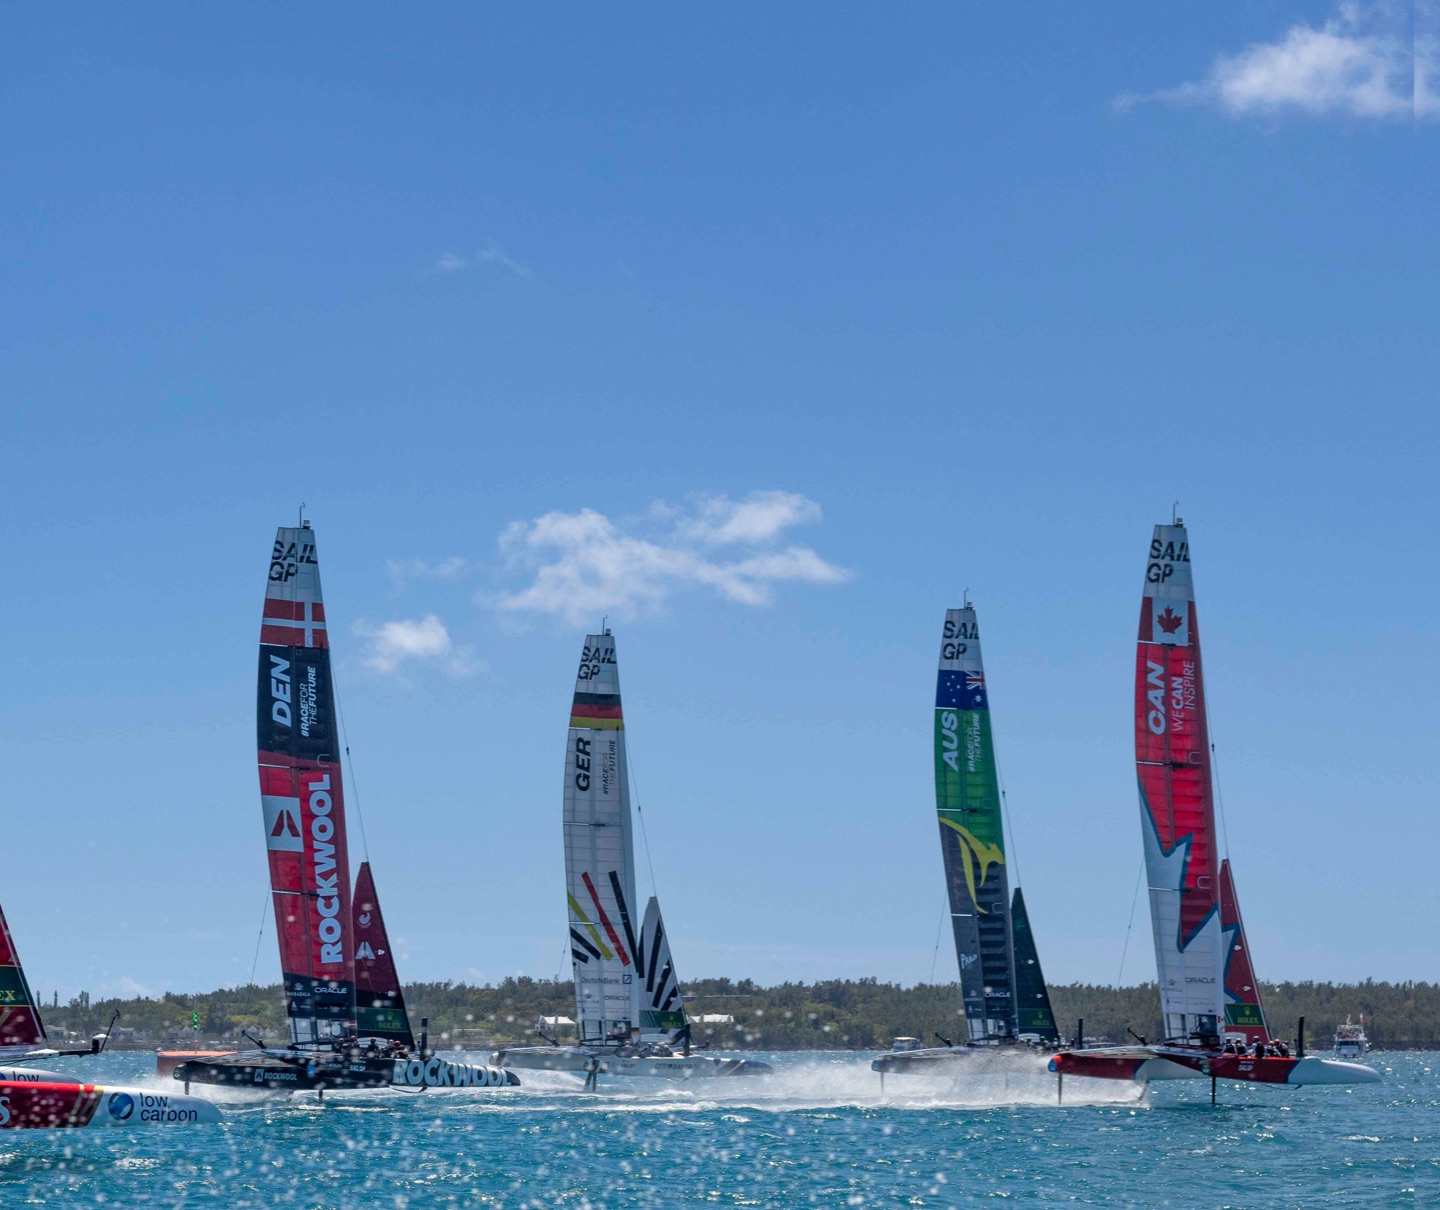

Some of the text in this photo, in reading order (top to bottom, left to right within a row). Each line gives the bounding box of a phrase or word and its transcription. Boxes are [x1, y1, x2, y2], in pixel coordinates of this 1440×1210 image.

[271, 540, 318, 565] SAIL
[1150, 538, 1190, 562] SAIL
[269, 561, 298, 583] GP
[1147, 562, 1173, 583] GP
[943, 620, 980, 640] SAIL
[581, 646, 616, 664] SAIL
[942, 642, 967, 660] GP
[577, 664, 601, 680] GP
[270, 655, 291, 727] DEN
[308, 666, 316, 725] THEFUTURE
[1147, 660, 1165, 734] CAN
[1184, 660, 1195, 710] INSPIRE
[301, 682, 310, 737] #RACEFOR
[1171, 676, 1184, 731] WE CAN
[941, 711, 958, 772] AUS
[576, 737, 591, 791] GER
[309, 774, 343, 964] ROCKWOOL
[13, 1070, 40, 1082] low
[264, 1072, 297, 1081] ROCKWOOL
[392, 1058, 512, 1087] ROCKWOOL
[139, 1092, 168, 1108] low
[140, 1105, 198, 1122] carbon
